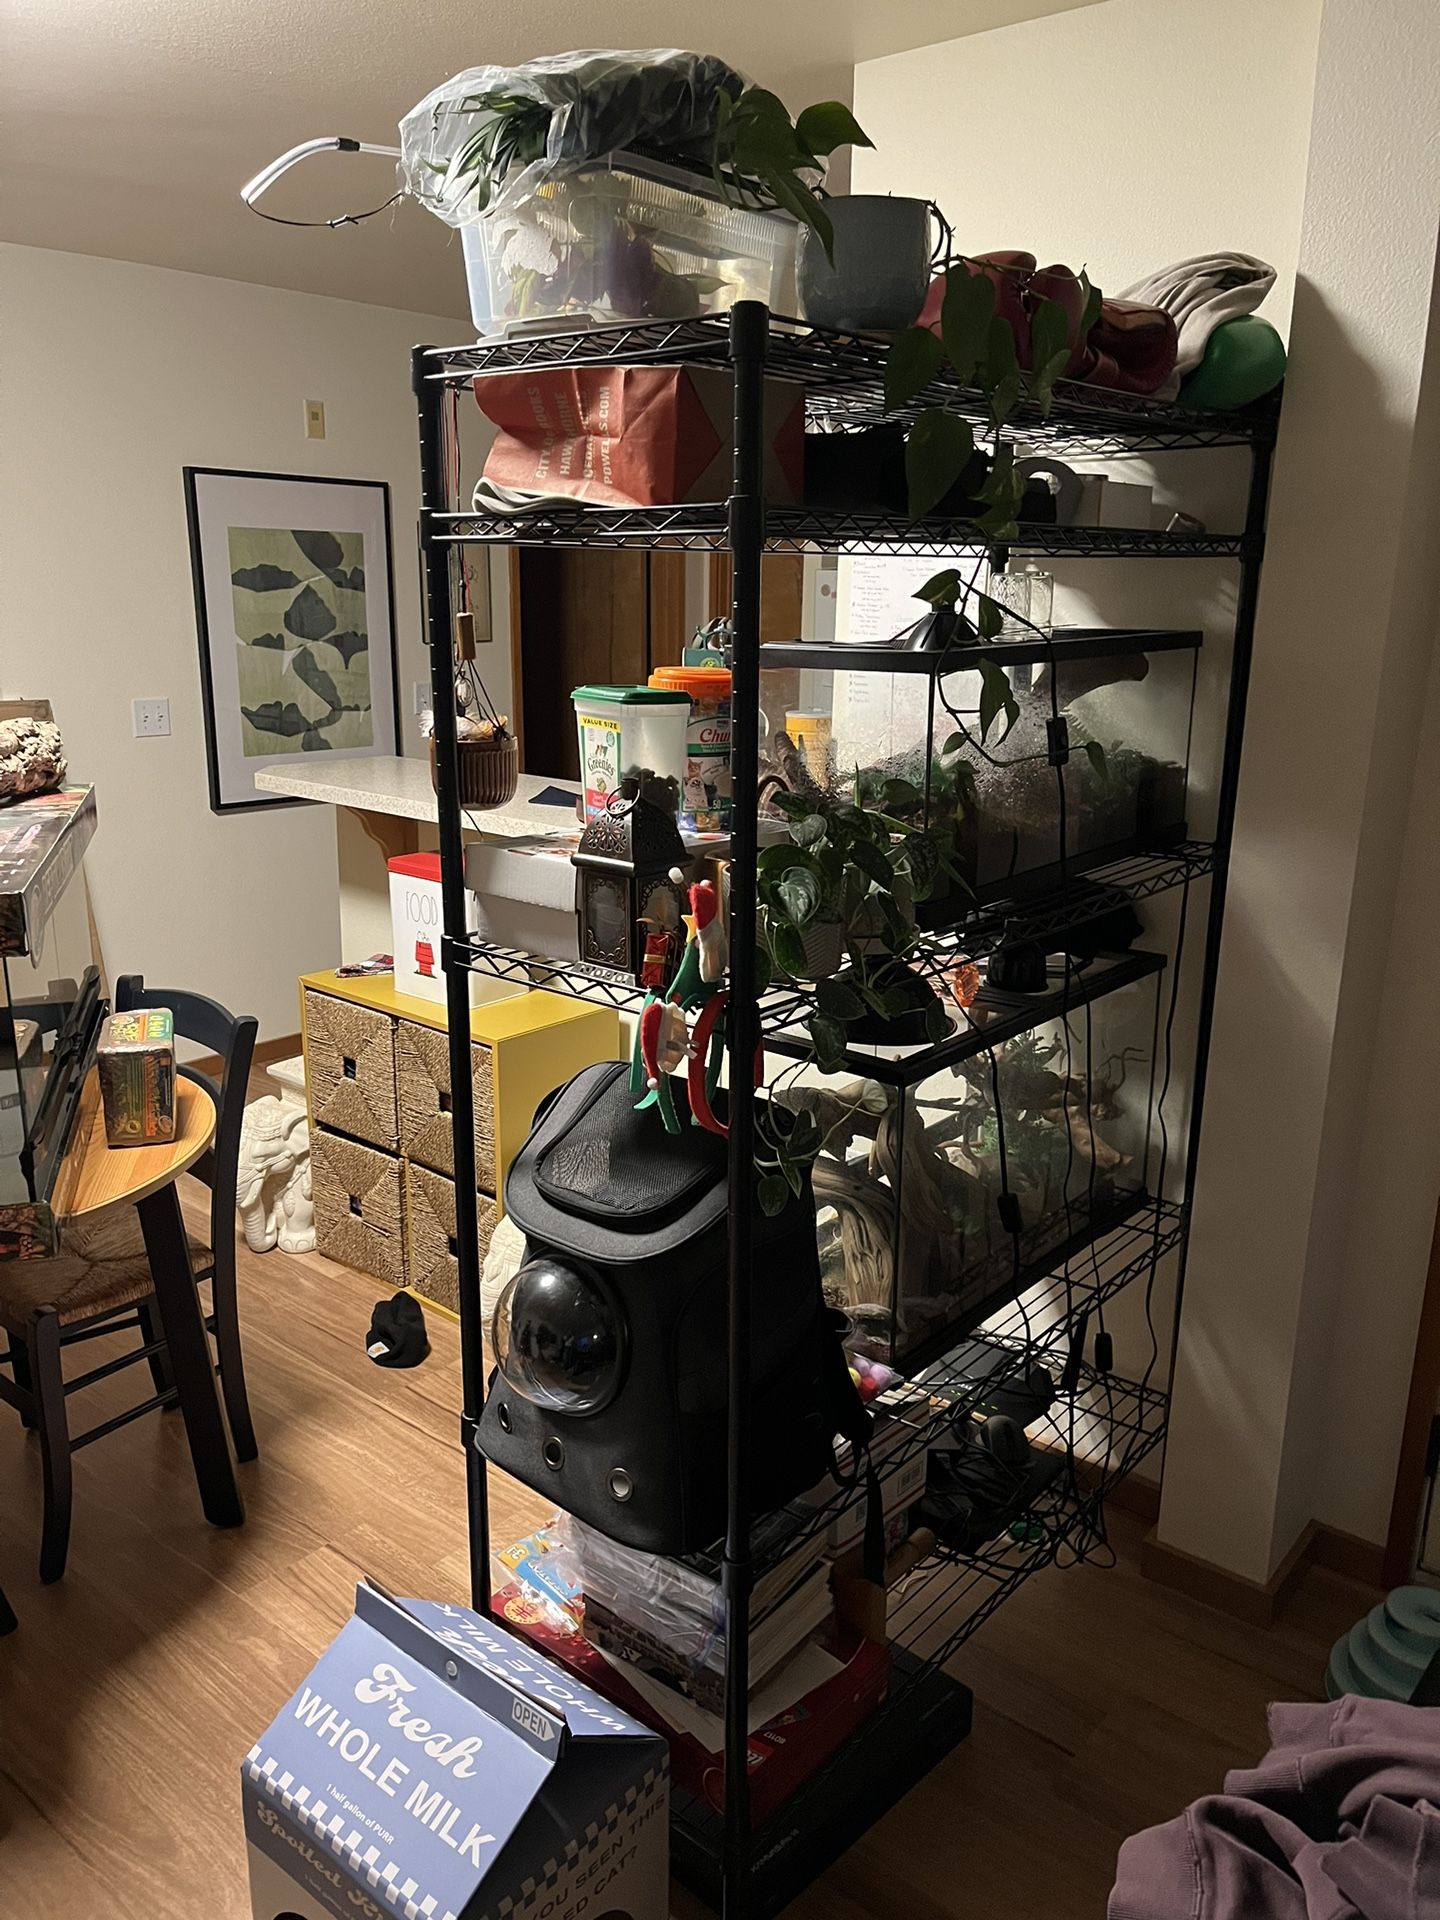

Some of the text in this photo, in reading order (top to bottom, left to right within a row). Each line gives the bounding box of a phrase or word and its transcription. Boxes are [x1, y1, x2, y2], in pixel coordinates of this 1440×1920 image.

[535, 449, 551, 479] CITY
[582, 717, 617, 730] VALUE SIZE
[431, 1602, 508, 1654] MILK
[354, 1663, 483, 1779] Fresh
[504, 1659, 627, 1731] WHOLE
[513, 1701, 548, 1738] OPEN
[294, 1687, 497, 1869] WHOLE MILK
[257, 1800, 341, 1888] Spoiled
[326, 1783, 395, 1845] 1 half gallon of PURR
[533, 1793, 666, 1920] OU SEEN THIS
